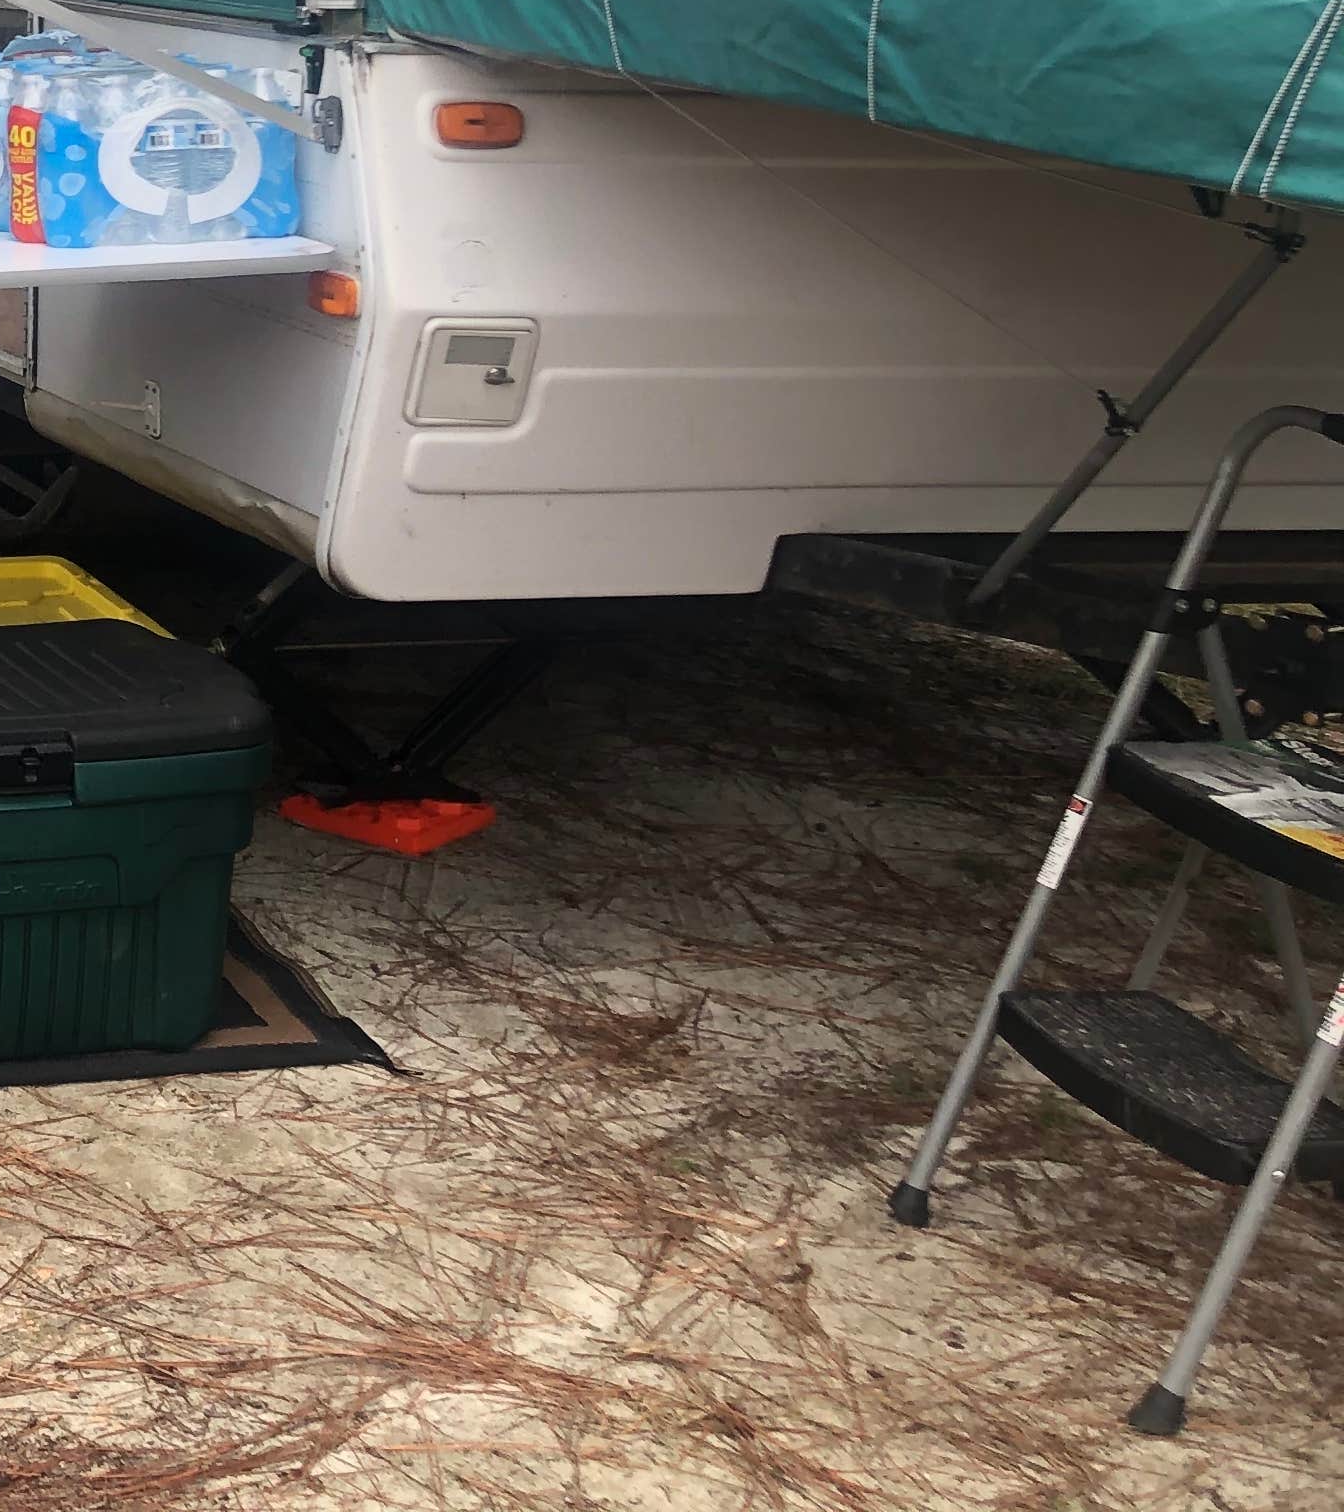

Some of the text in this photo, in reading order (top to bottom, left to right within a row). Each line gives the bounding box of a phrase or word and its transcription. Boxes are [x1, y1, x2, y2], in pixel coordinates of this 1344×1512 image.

[9, 125, 36, 147] 40
[12, 173, 22, 223] PACK
[22, 171, 38, 225] VALUE
